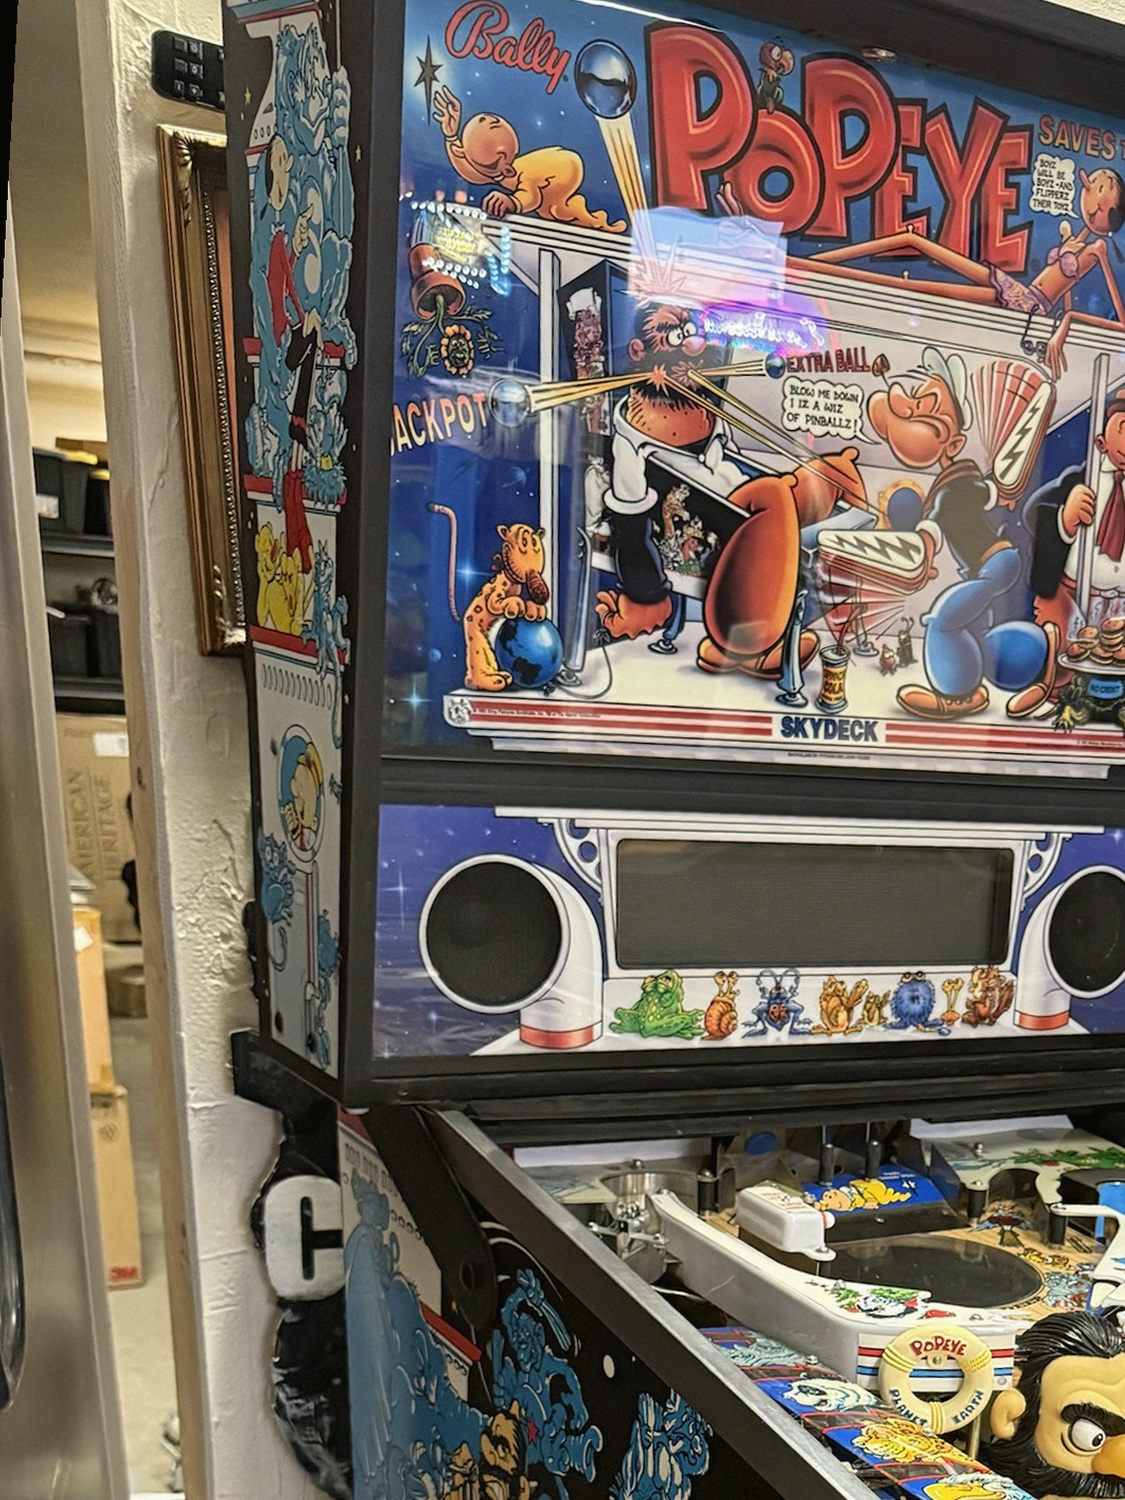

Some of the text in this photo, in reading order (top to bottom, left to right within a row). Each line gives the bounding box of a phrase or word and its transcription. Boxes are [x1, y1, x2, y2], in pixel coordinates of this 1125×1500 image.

[444, 1, 570, 95] Bally
[644, 19, 1034, 273] POPEYE
[1038, 113, 1117, 161] SAVES
[1037, 168, 1066, 181] WILL BE
[1039, 158, 1057, 169] BOYZ
[1035, 187, 1070, 201] FLIPPERZ
[786, 346, 871, 374] EXTRA BALL
[789, 384, 859, 403] BLOW ME DOWN
[789, 398, 844, 414] I IZ A WIZ
[390, 393, 487, 457] ACKPOT
[787, 412, 859, 434] OF PINBALLZ!
[781, 715, 879, 743] SKYDECK
[909, 1335, 967, 1356] POPEYE
[889, 1388, 928, 1426] PLANET
[951, 1390, 985, 1425] EARTH
